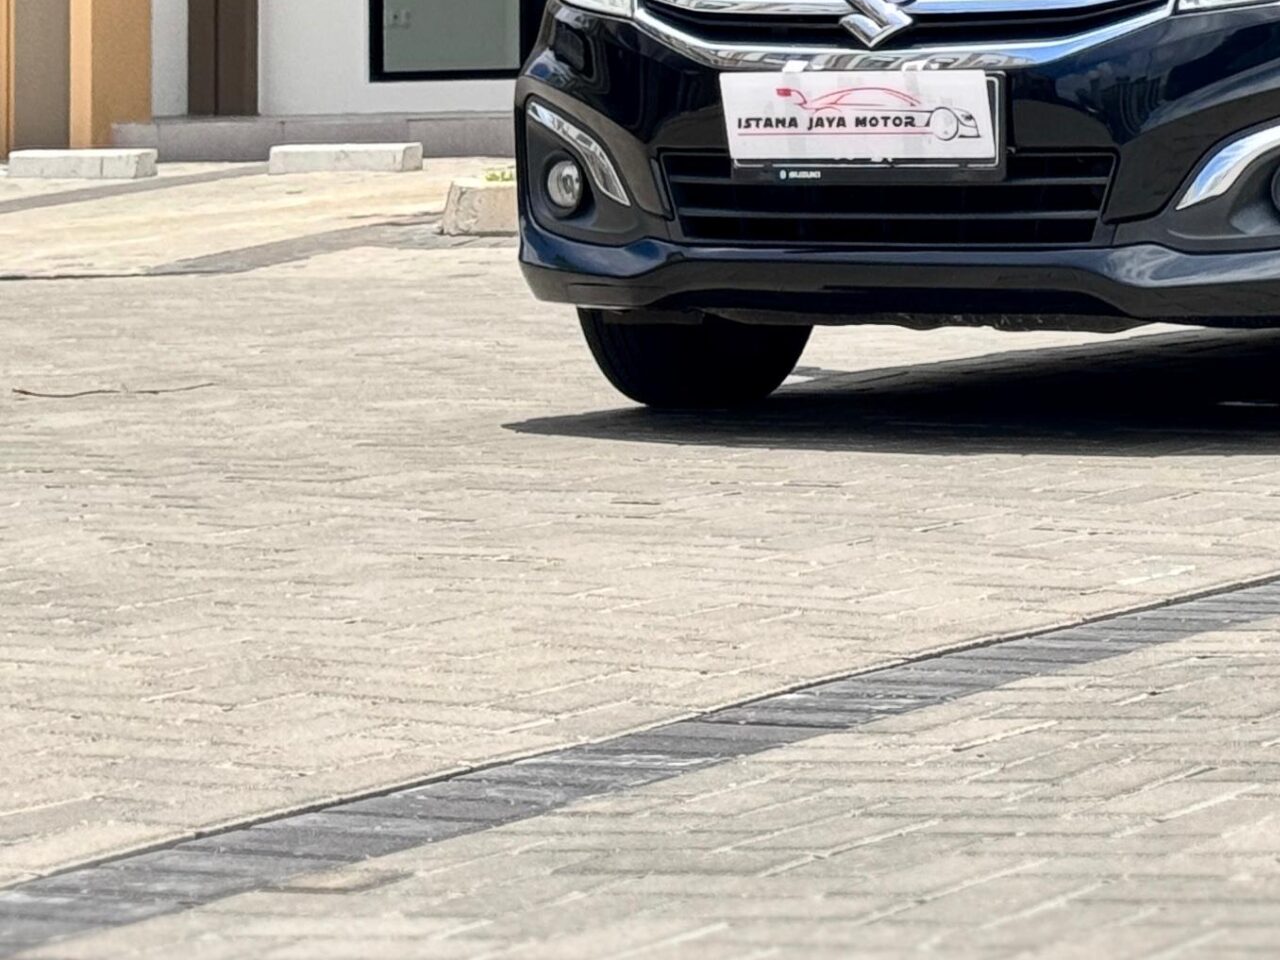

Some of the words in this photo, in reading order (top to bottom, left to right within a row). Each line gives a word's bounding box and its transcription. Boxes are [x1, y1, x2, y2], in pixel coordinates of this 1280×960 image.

[737, 117, 798, 129] ISTANA
[807, 117, 846, 131] JAYA
[854, 116, 916, 127] MOTOR
